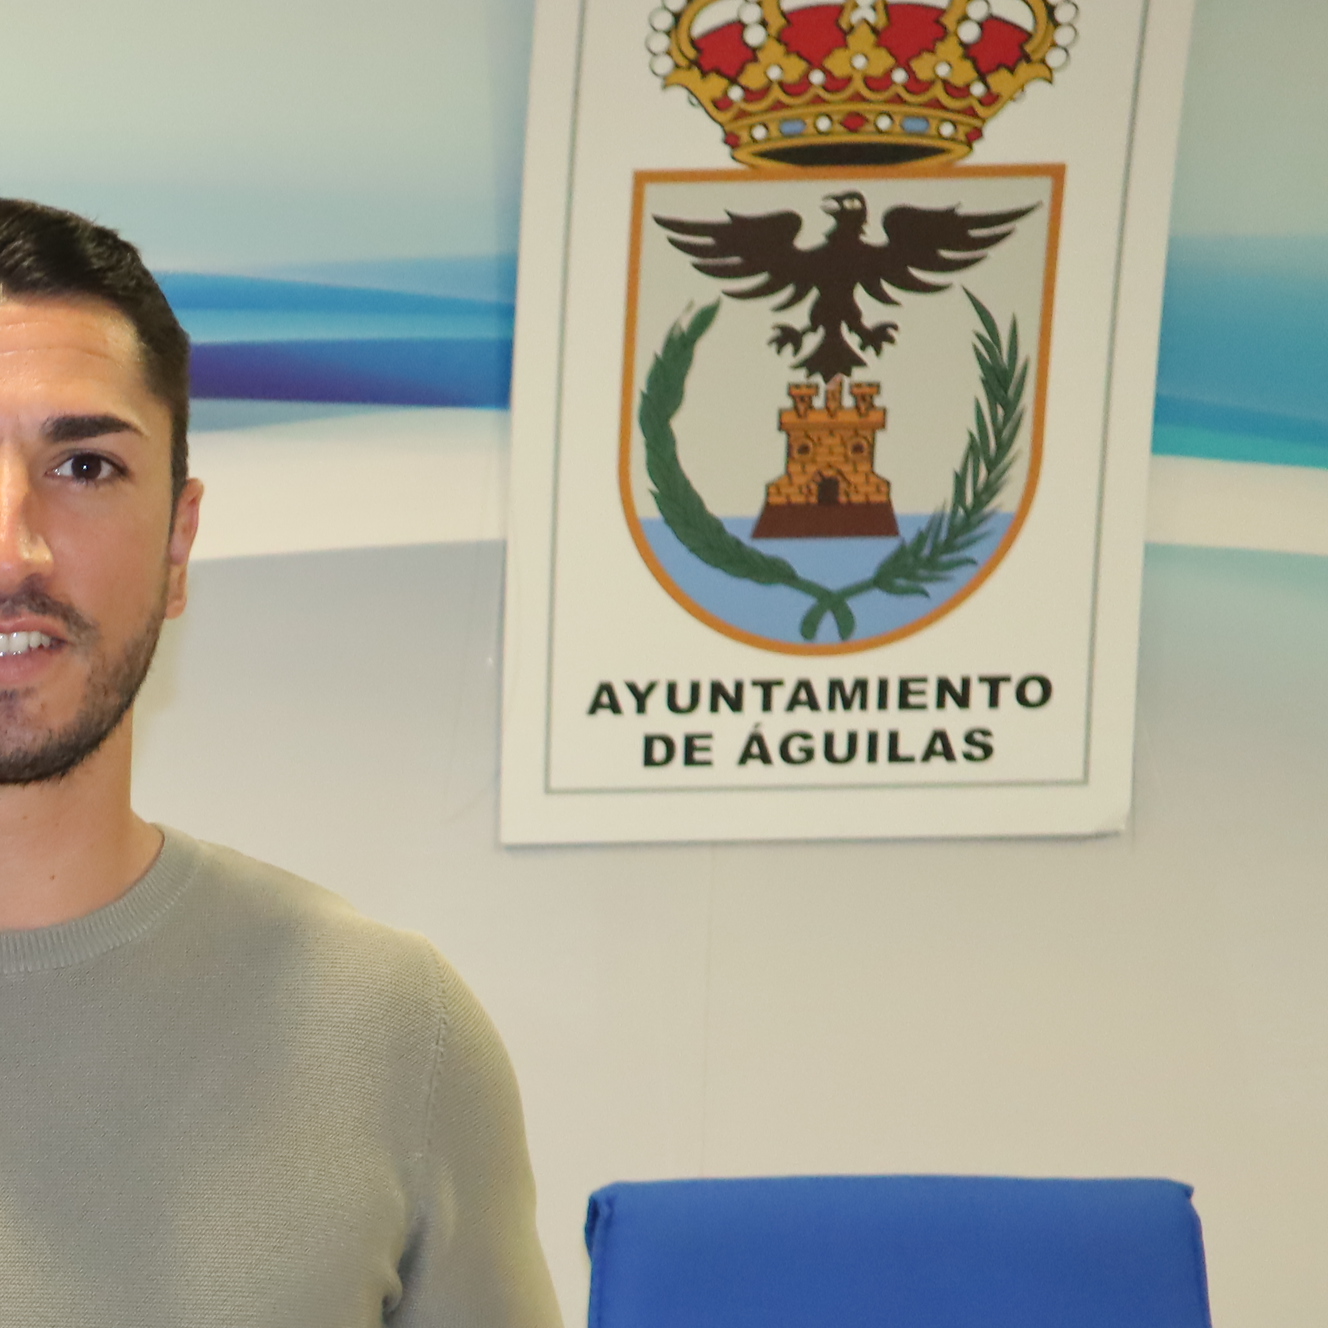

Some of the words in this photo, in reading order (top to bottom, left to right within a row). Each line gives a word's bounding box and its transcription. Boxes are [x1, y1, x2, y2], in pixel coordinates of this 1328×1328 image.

[586, 674, 1054, 716] AYUNTAMIENTO
[644, 732, 714, 767] DE
[738, 722, 995, 766] ÁGUILAS
